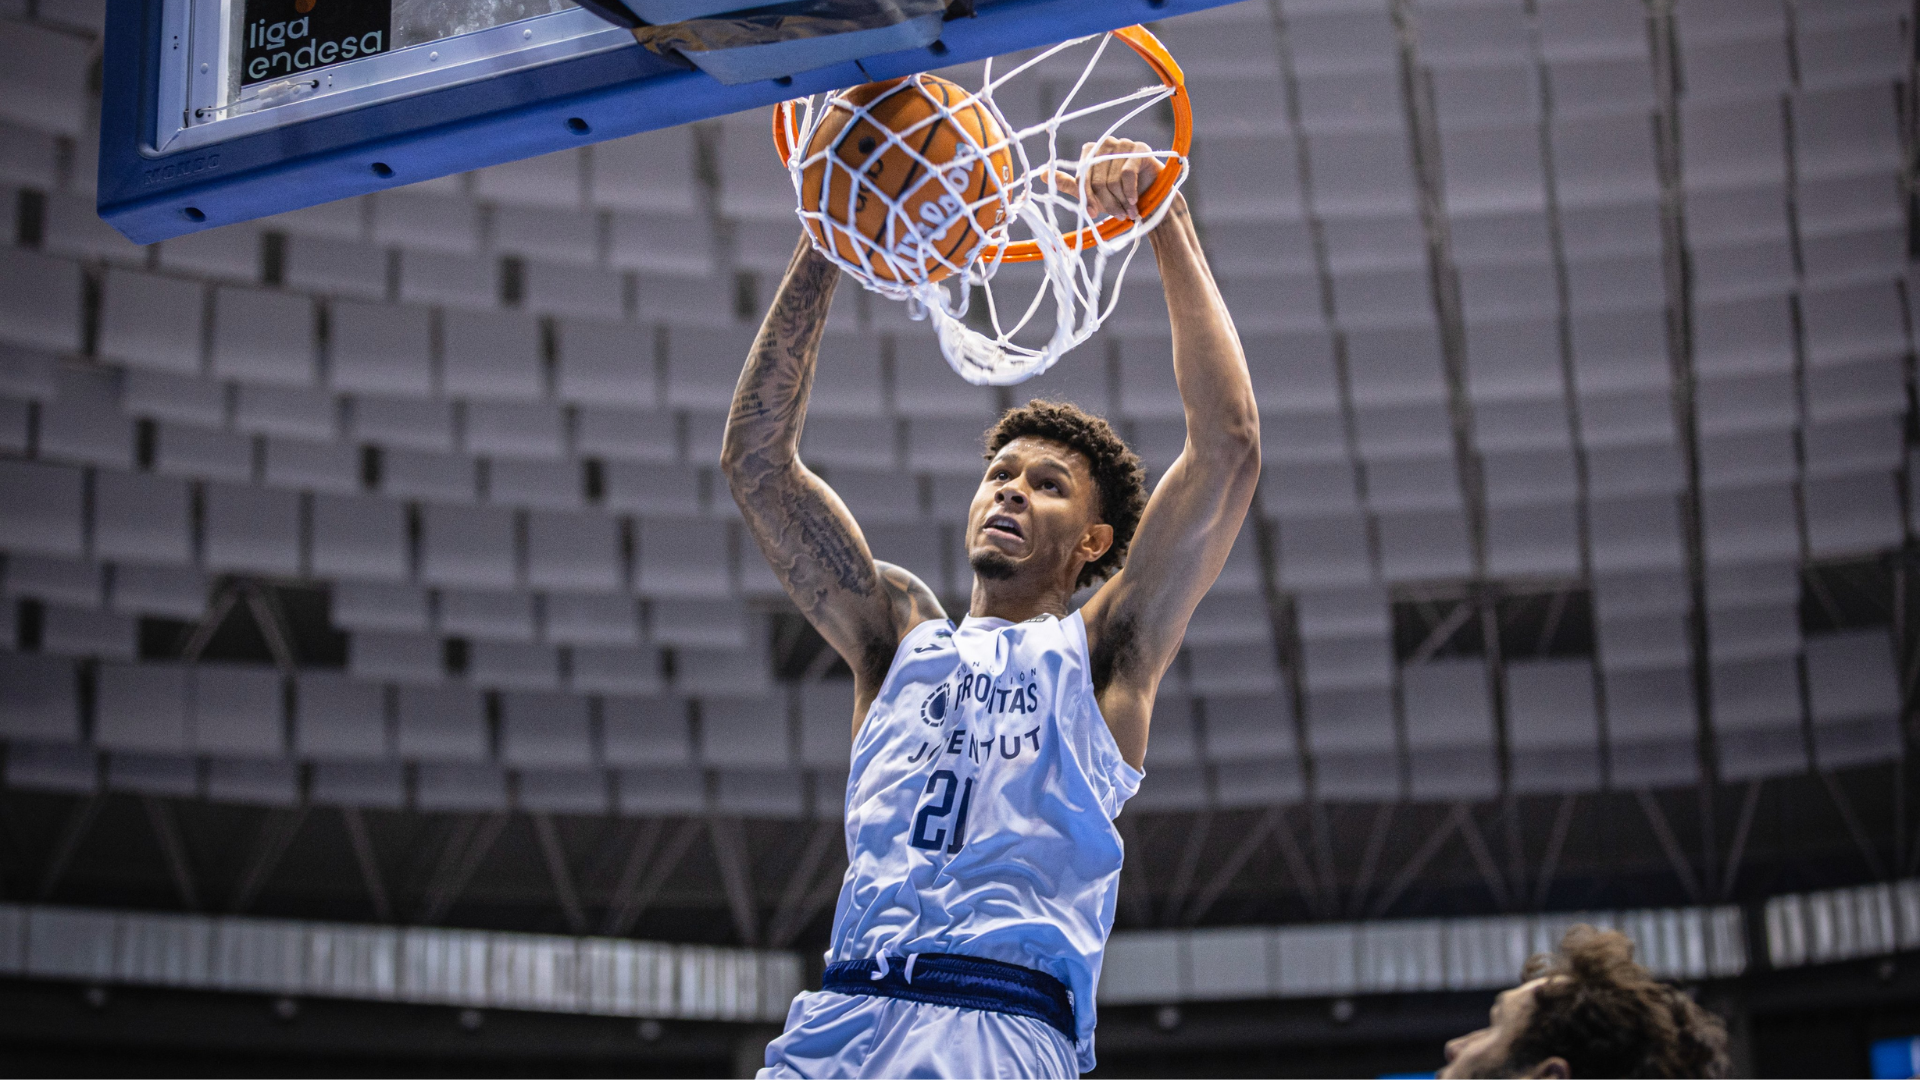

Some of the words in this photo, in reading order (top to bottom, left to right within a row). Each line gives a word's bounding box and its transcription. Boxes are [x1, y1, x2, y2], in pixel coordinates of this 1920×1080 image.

[249, 16, 310, 51] liga
[248, 30, 383, 79] endesa
[144, 154, 221, 185] MONDO
[956, 661, 1037, 685] FUNIÓN
[954, 673, 1038, 715] ROITAS
[907, 725, 1041, 765] JENTUT
[911, 769, 973, 855] 21
